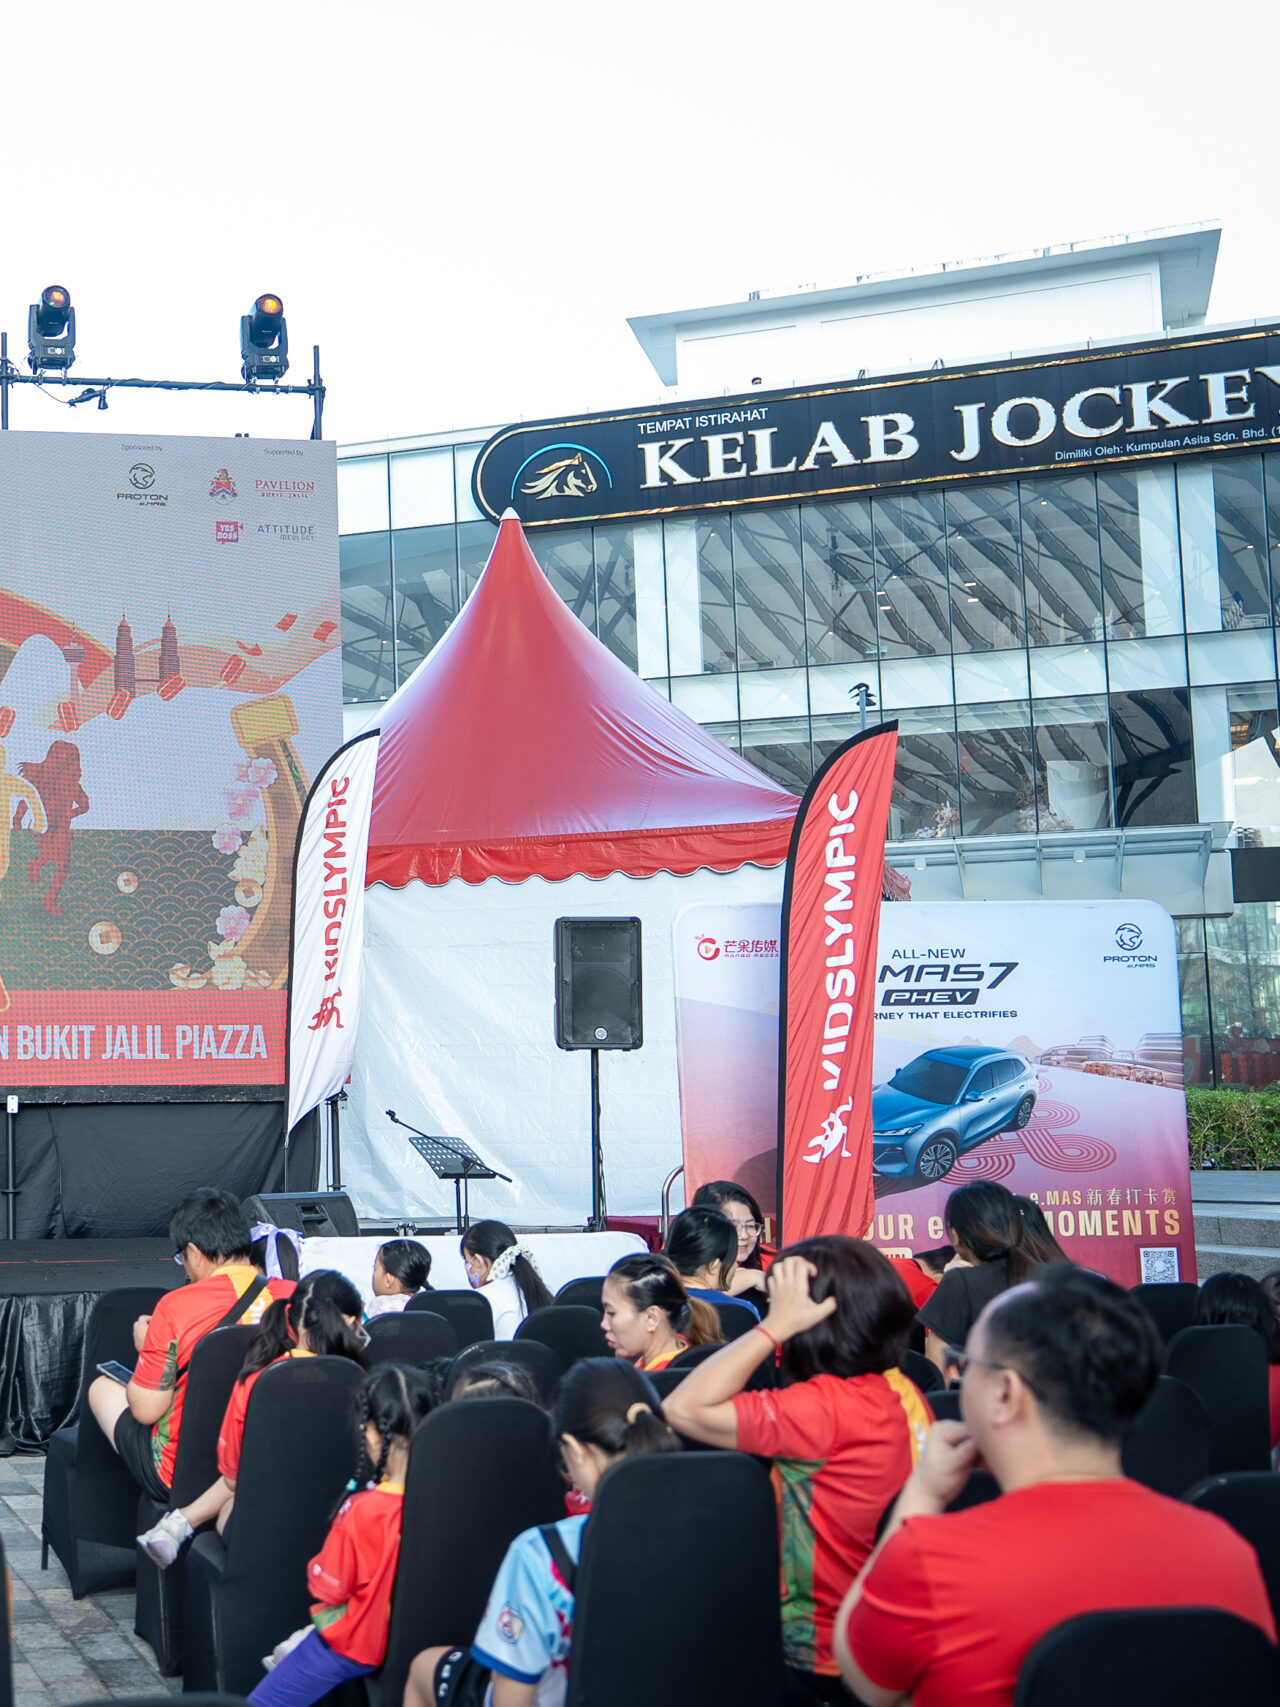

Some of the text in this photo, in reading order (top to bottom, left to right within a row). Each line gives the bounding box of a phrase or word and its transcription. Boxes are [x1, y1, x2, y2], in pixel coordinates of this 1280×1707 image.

[637, 407, 769, 435] TEMPAT ISTIRAHAT
[121, 443, 163, 452] Sponsored by
[1055, 448, 1092, 461] Dimiliki
[1095, 445, 1123, 456] Oleh:
[1126, 439, 1181, 453] Kumpulan
[1183, 434, 1210, 447] Asita
[1213, 432, 1239, 442] Sdn.
[1242, 427, 1268, 439] Bhd.
[264, 448, 304, 457] Supported by
[637, 412, 921, 490] KELAB
[255, 479, 315, 490] PAVILION
[116, 493, 168, 501] PROTON
[219, 524, 235, 532] YES
[257, 524, 314, 534] ATTITUDE
[724, 939, 779, 953] 芒果传媒
[891, 948, 966, 959] ALL-NEW
[889, 991, 973, 1004] PHEV
[908, 1011, 940, 1020] THAT
[943, 1010, 1018, 1019] ELECTRIFIES
[17, 1025, 96, 1060] BUKIT
[102, 1025, 170, 1060] JALIL
[176, 1025, 268, 1059] PIAZZA
[1086, 1187, 1177, 1207] 新春打卡赏
